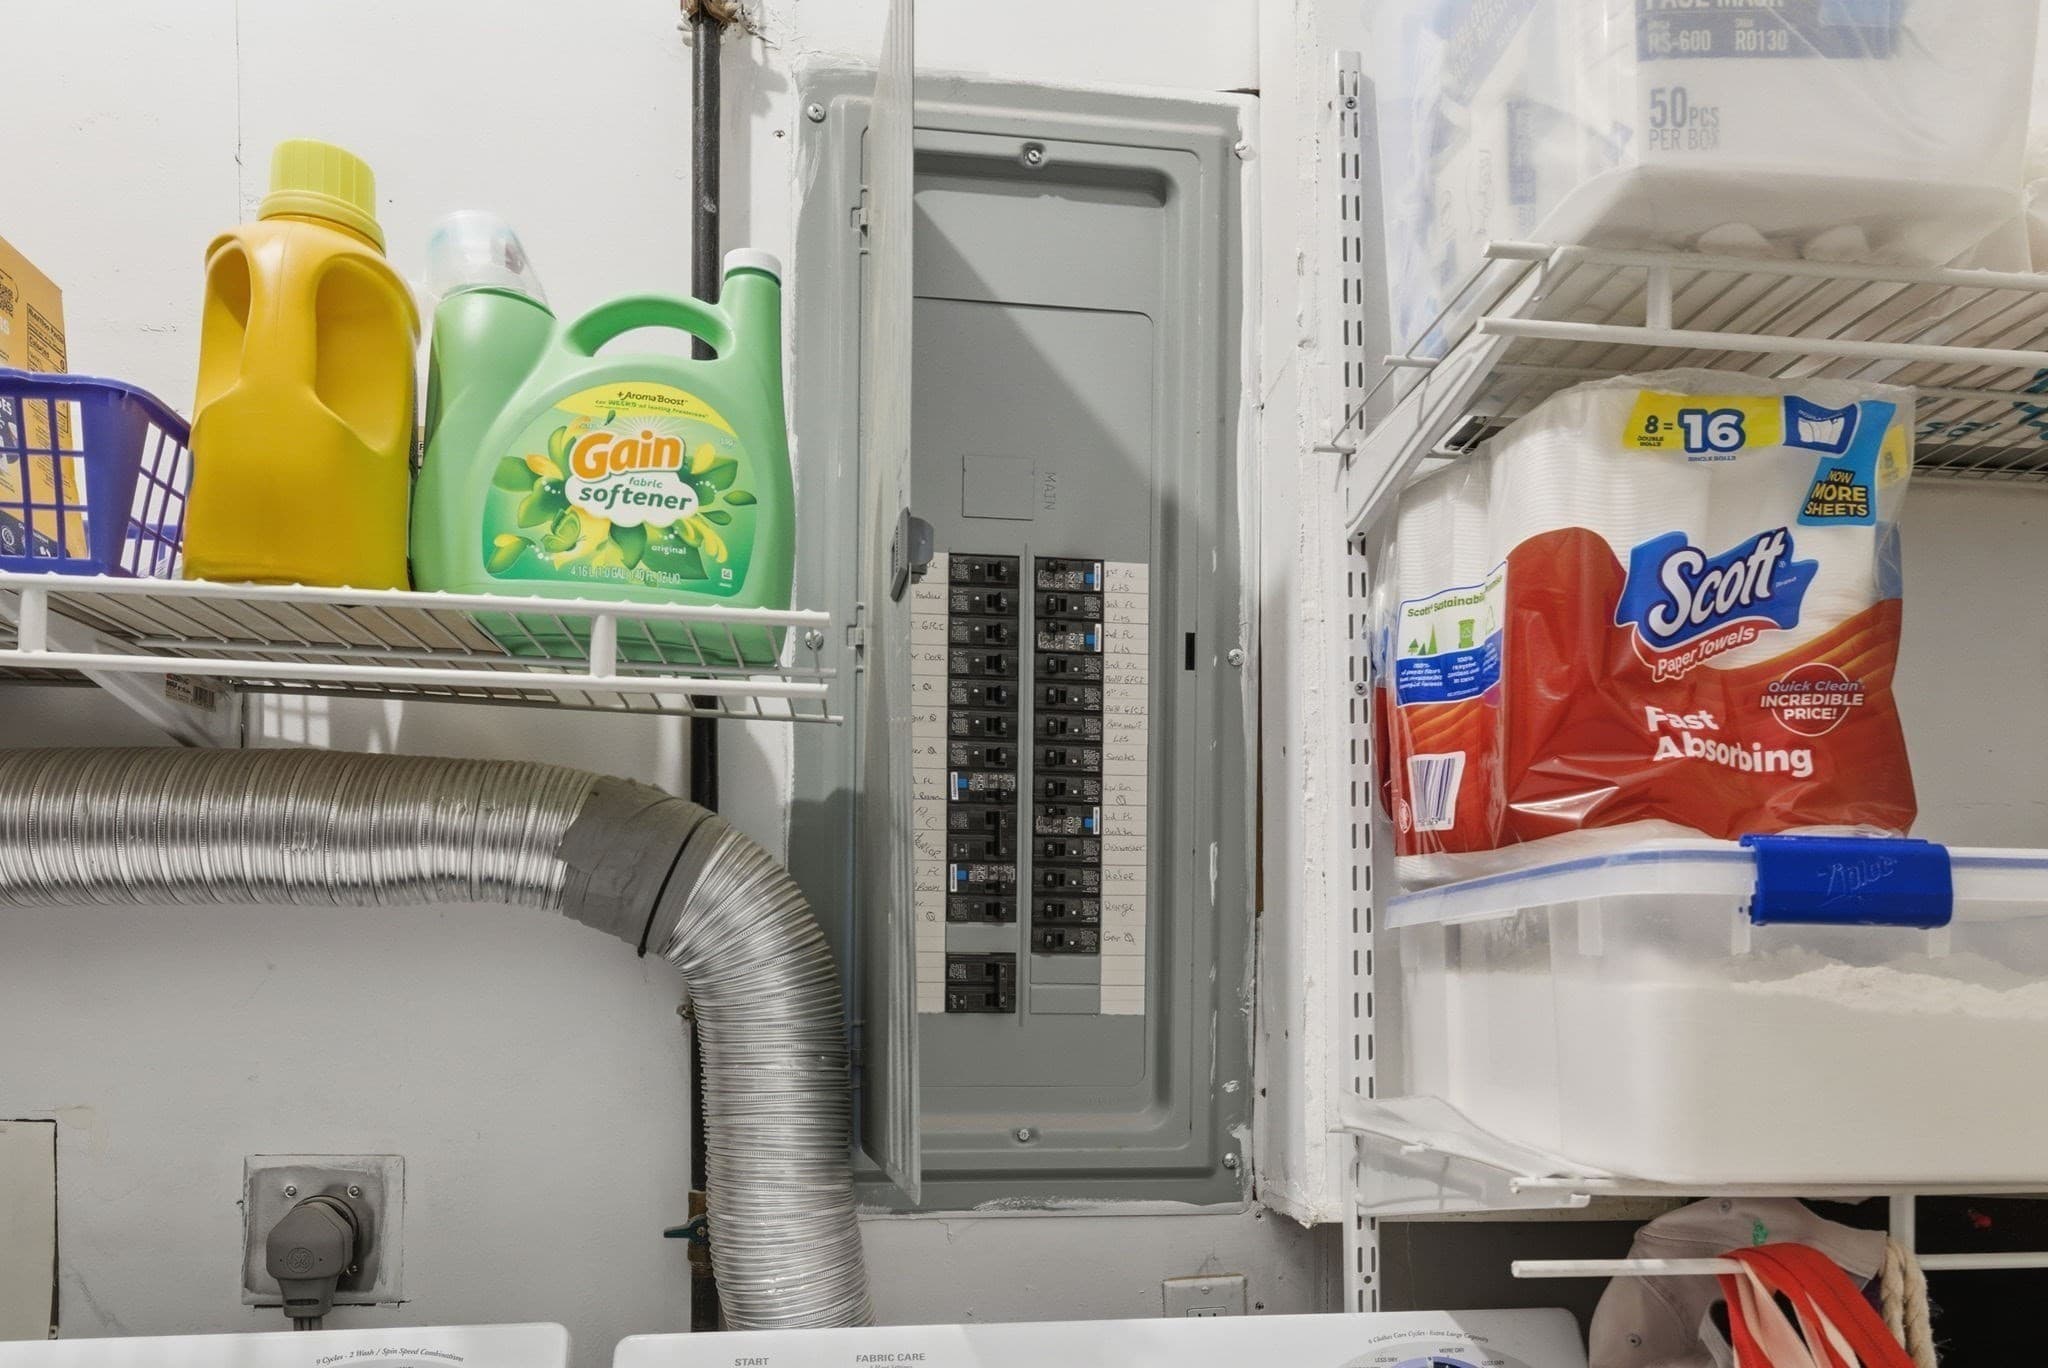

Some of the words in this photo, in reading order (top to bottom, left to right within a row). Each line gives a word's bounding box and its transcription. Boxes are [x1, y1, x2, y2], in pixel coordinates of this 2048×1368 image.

[1649, 129, 1681, 150] PER
[1645, 415, 1658, 433] 8
[1683, 414, 1740, 449] 16
[573, 430, 681, 479] Gain
[629, 476, 663, 489] fabric
[1829, 470, 1853, 483] NOW
[579, 484, 692, 510] softener
[1812, 483, 1867, 501] MORE
[1805, 502, 1867, 516] SHEETS
[651, 544, 687, 555] original
[1649, 530, 1785, 637] Scott
[1657, 649, 1697, 676] Paper
[1699, 626, 1755, 659] Towels
[1769, 681, 1810, 693] Quick
[1760, 693, 1864, 707] INCREDIBLE
[1645, 706, 1720, 732] Fast
[1784, 707, 1837, 720] PRICE!
[1653, 731, 1813, 778] Absorbing
[322, 1354, 344, 1365] Cycles
[420, 1348, 464, 1362] Combinations
[734, 1357, 770, 1367] START
[856, 1354, 895, 1362] FABRIC
[897, 1352, 926, 1361] CARE
